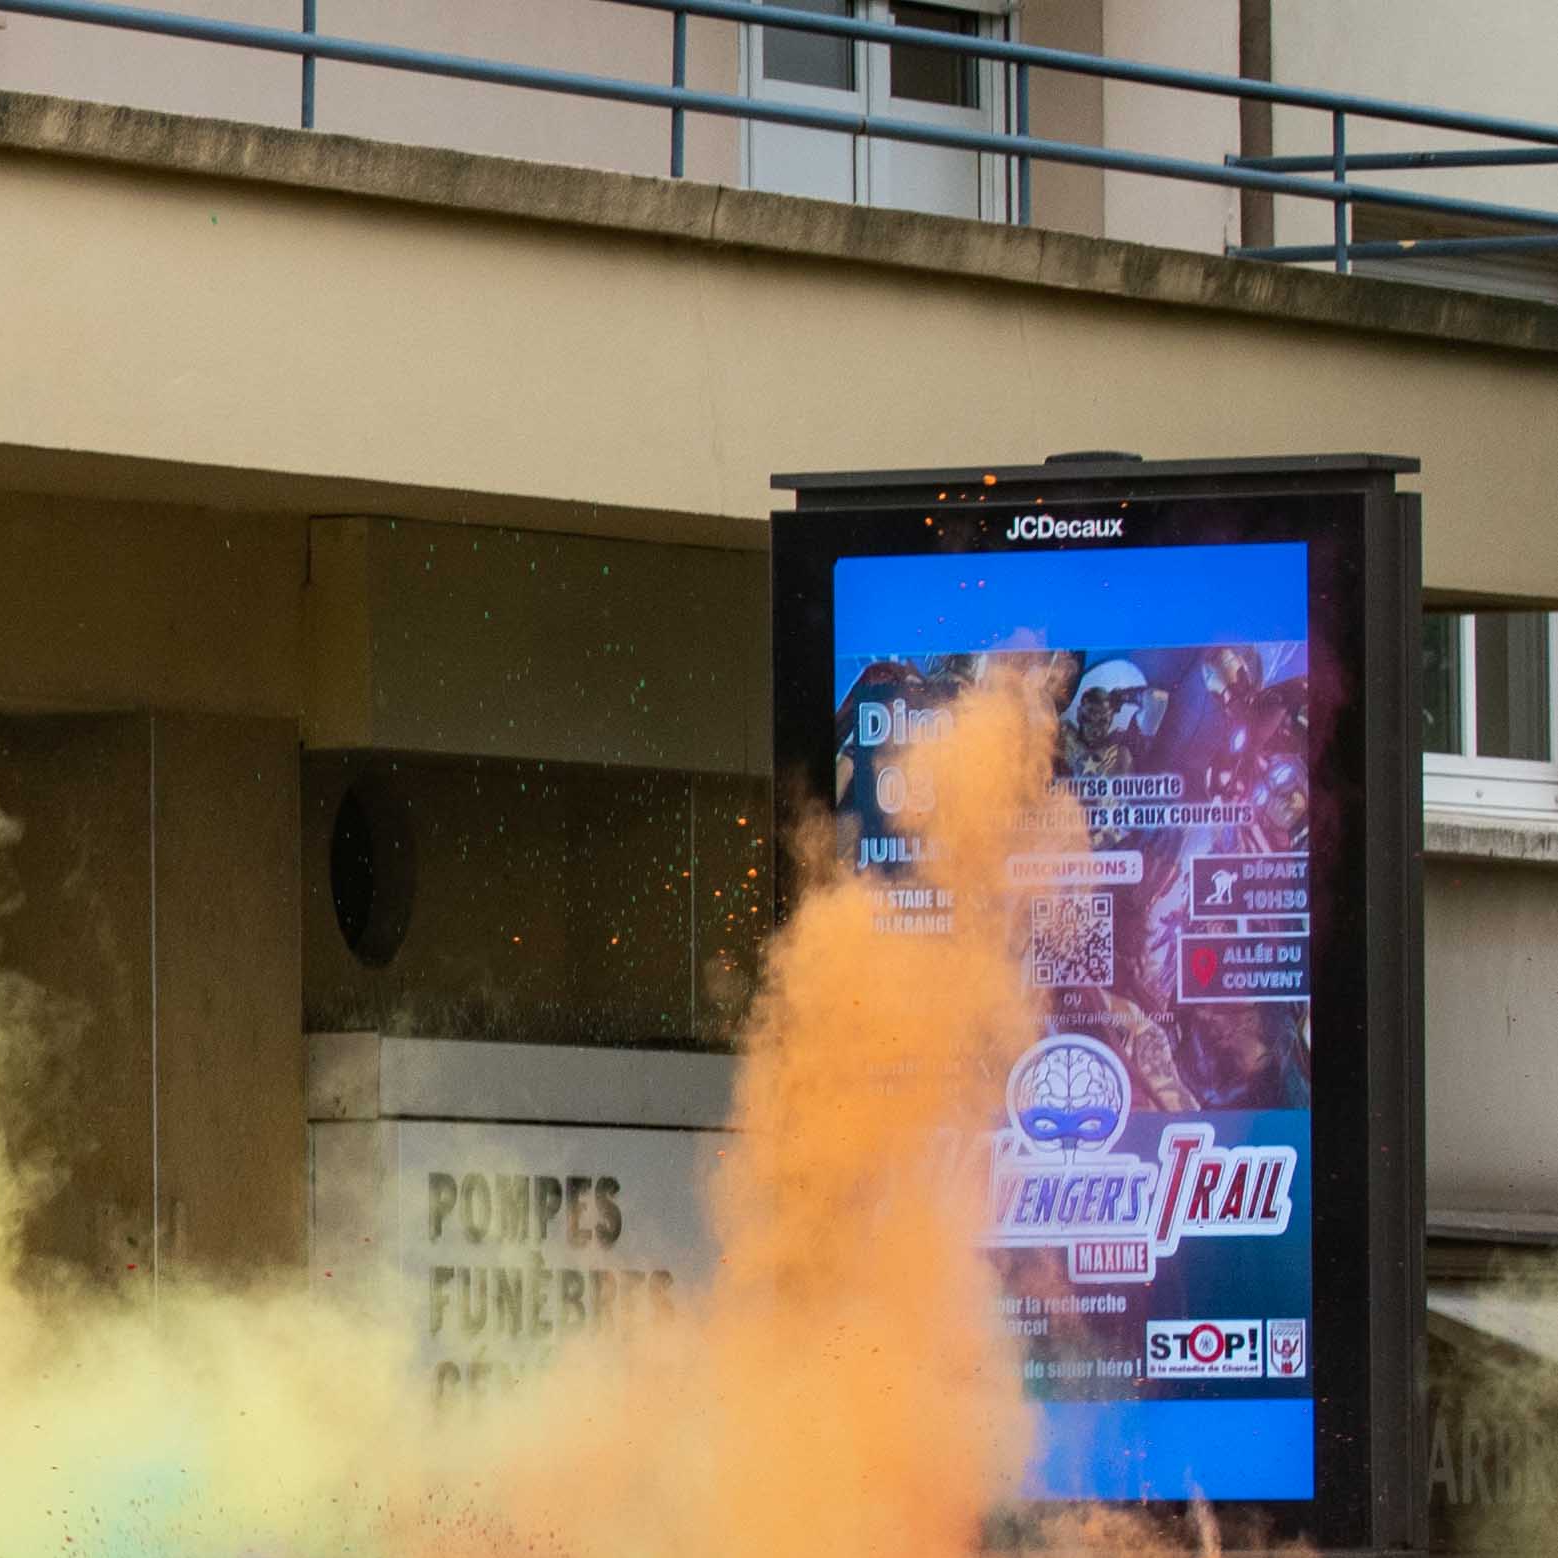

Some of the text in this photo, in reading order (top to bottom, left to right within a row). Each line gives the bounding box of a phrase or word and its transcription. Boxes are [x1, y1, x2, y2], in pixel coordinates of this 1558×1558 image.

[1006, 514, 1124, 540] JCDecaux
[1111, 774, 1182, 797] ouverte
[1112, 806, 1131, 826] et
[1133, 807, 1166, 826] aux
[1169, 804, 1253, 825] coureurs
[1242, 860, 1308, 879] DÉPART
[887, 888, 933, 908] STADE
[1243, 889, 1308, 910] 10H30
[1223, 944, 1302, 964] ALLÉE DU
[1221, 970, 1304, 989] COUVENT
[1156, 1139, 1284, 1244] TRAIL
[429, 1172, 623, 1249] POMPES
[1078, 1244, 1148, 1274] MAXIME
[1025, 1294, 1042, 1314] la
[1044, 1293, 1128, 1314] recherche
[1150, 1323, 1258, 1364] STOP!
[1024, 1360, 1045, 1378] de
[1095, 1357, 1134, 1378] héro
